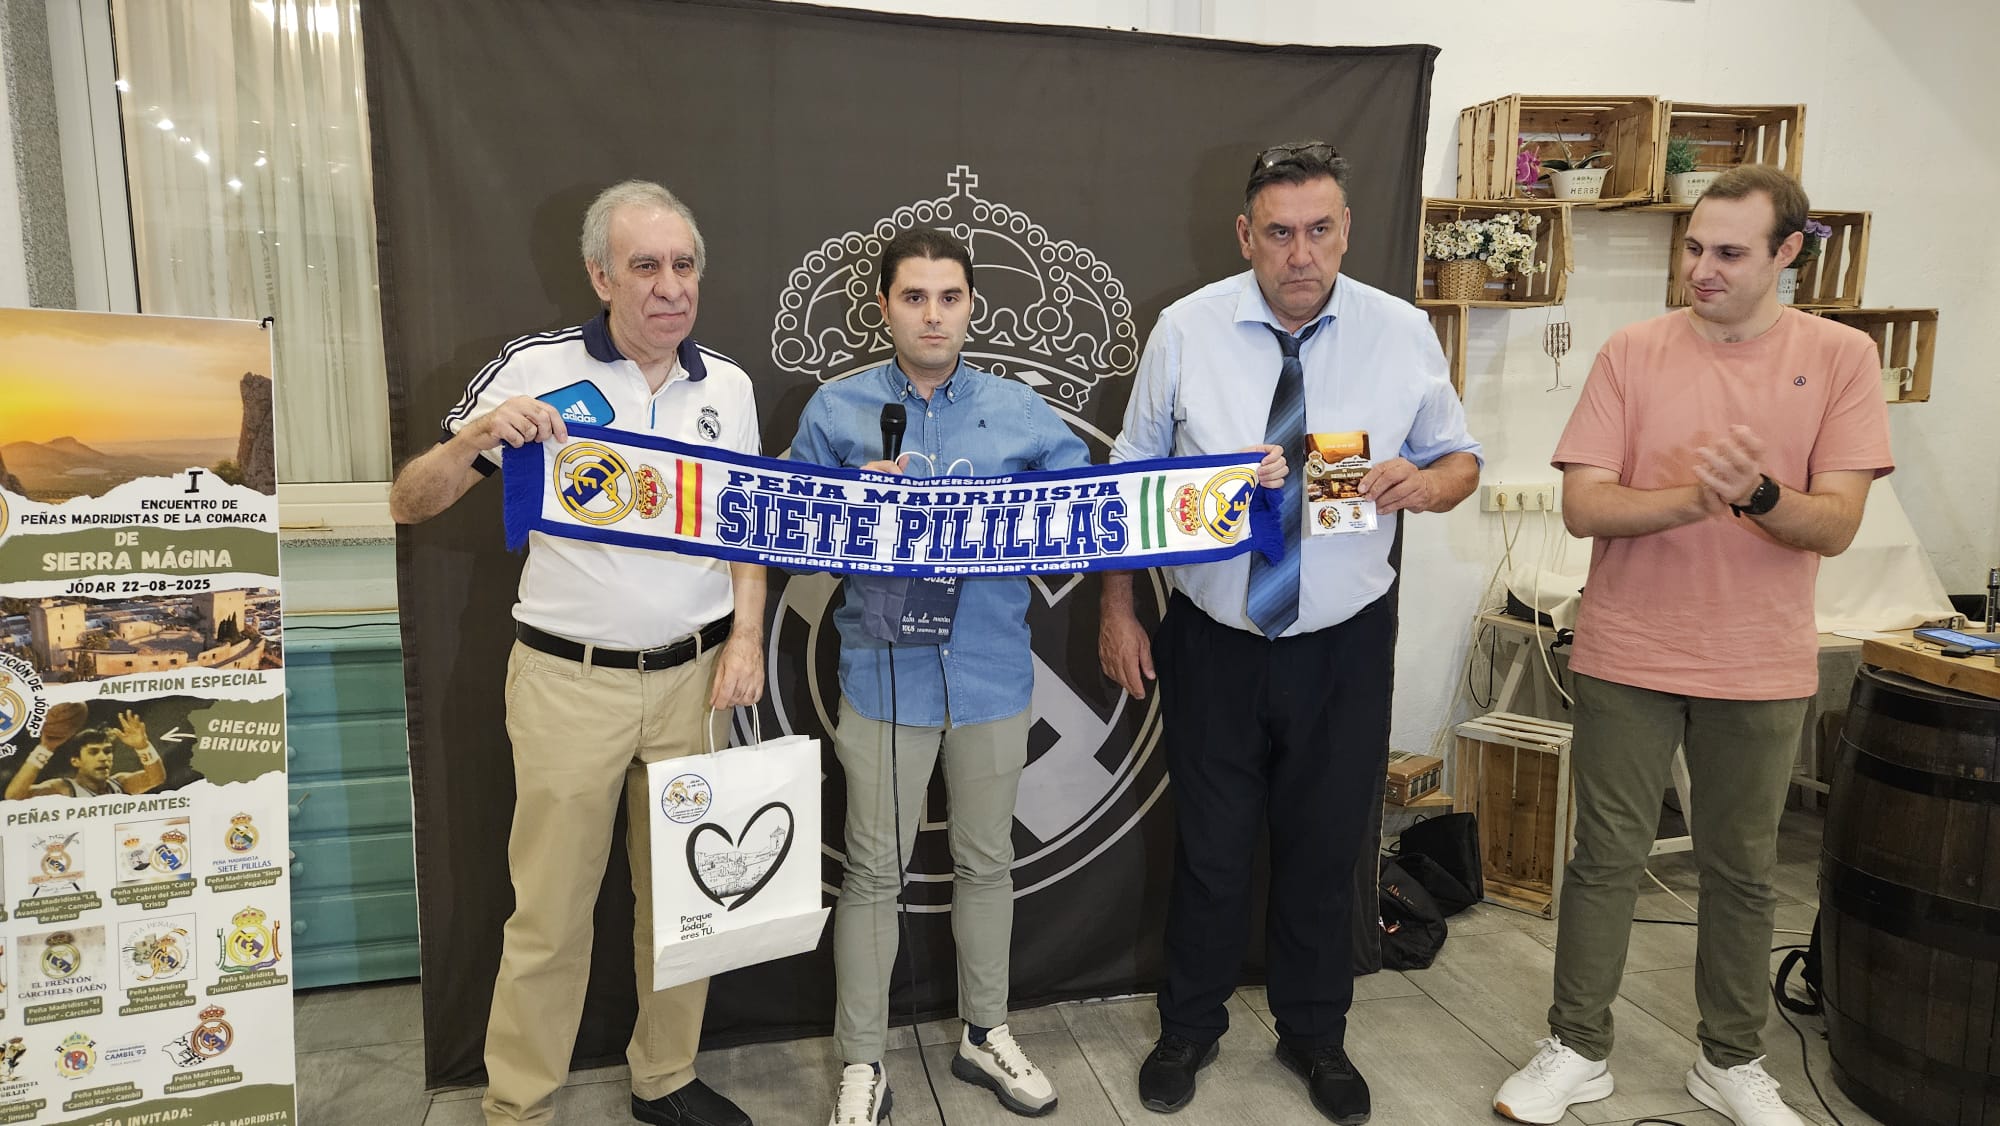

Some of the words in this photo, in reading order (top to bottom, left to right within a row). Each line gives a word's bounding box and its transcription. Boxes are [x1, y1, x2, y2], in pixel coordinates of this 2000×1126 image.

[562, 412, 598, 423] adidas
[184, 470, 203, 494] I
[859, 473, 895, 484] XXX
[900, 476, 1013, 486] ANIVERSARIO
[728, 470, 847, 500] PEÑA
[864, 481, 1120, 506] MADRIDISTA
[141, 500, 216, 510] ENCUENTRO
[222, 500, 238, 510] DE
[21, 511, 66, 525] PEÑAS
[71, 513, 159, 524] MADRIDISTAS
[164, 513, 180, 524] DE
[185, 513, 202, 524] LA
[206, 513, 267, 523] COMARCA
[716, 486, 880, 559] SIETE
[892, 497, 1129, 562] PILILLAS
[115, 532, 139, 546] DE
[42, 551, 132, 572] SIERRA
[142, 544, 232, 569] MÁGINA
[758, 554, 844, 568] Fundada
[849, 562, 894, 572] 1993
[934, 563, 1026, 574] Pegalajar
[1031, 560, 1090, 571] (Jaén)
[66, 578, 115, 594] JÓDAR
[122, 579, 210, 592] 22-08-2025
[28, 678, 43, 692] DE
[100, 678, 185, 695] ANFITRION
[191, 673, 267, 689] ESPECIAL
[208, 719, 280, 736] CHECHU
[199, 736, 282, 754] BIRIUKOV
[7, 807, 60, 826] PEÑAS
[66, 796, 191, 820] PARTICIPANTES:
[218, 864, 238, 873] SIETE
[242, 860, 272, 870] PILILLAS
[226, 872, 261, 881] Madridista
[132, 884, 170, 893] Madridista
[41, 896, 81, 905] Madridista
[68, 901, 100, 910] Campillo
[680, 912, 712, 924] Porque
[680, 932, 700, 940] eres
[239, 971, 274, 980] Madridista
[148, 983, 186, 992] Madridista
[48, 1001, 88, 1011] Madridista
[104, 1050, 134, 1060] CAMBIL
[194, 1068, 230, 1079] Madridista
[93, 1084, 132, 1096] Madridista
